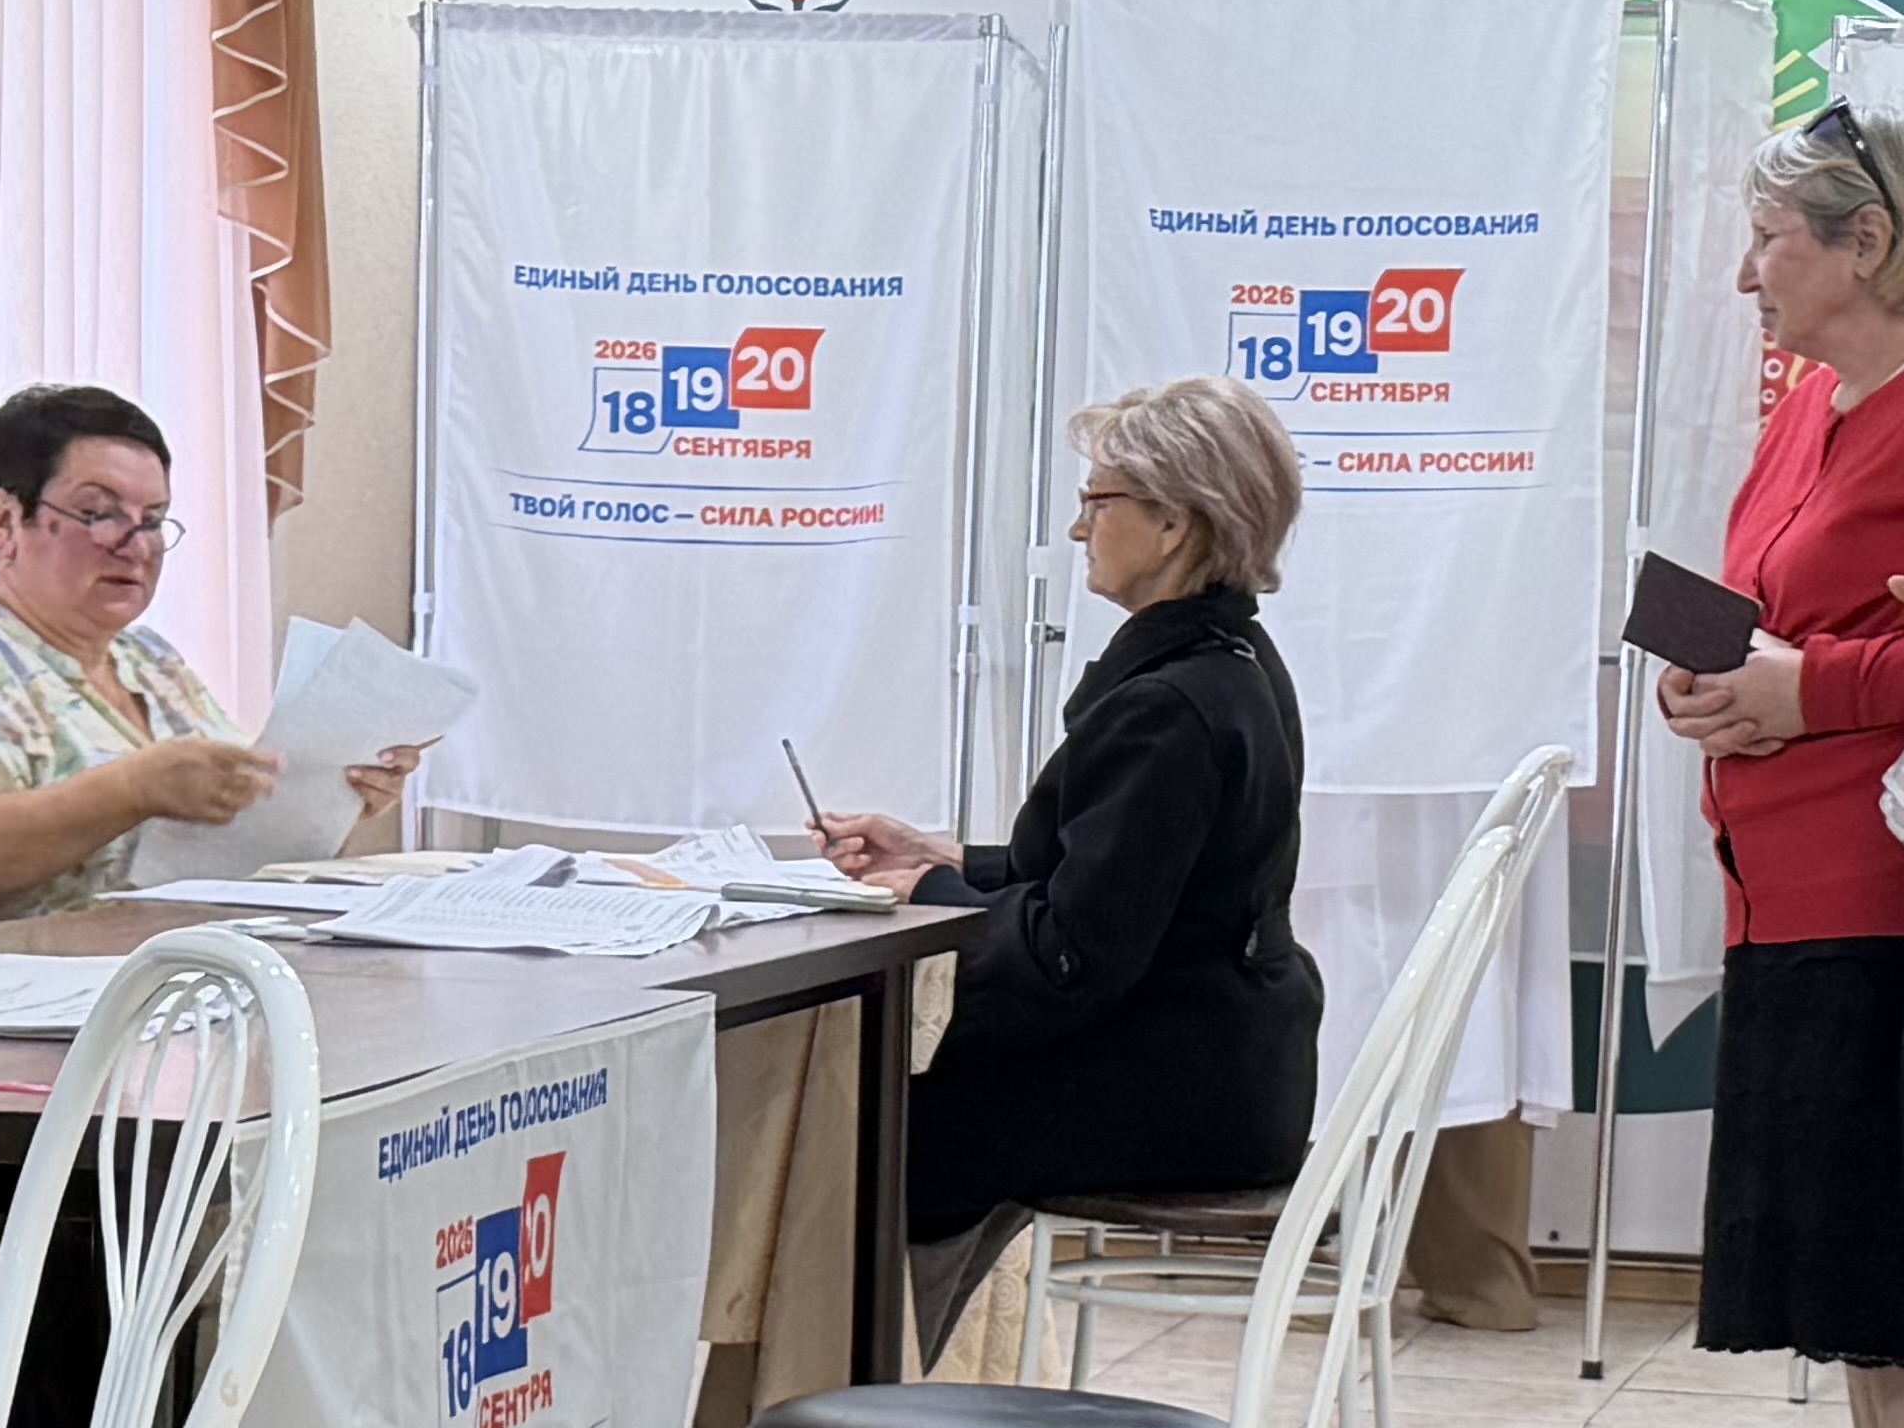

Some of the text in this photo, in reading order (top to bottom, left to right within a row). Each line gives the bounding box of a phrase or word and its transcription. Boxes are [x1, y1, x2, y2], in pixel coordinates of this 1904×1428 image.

[1149, 207, 1539, 239] ЕДИНЫЙ ДЕНЬ ГОЛОСОВАНИЯ
[514, 265, 904, 297] ЕДИНЫЙ ДЕНЬ ГОЛОСОВАНИЯ
[1231, 284, 1295, 305] 2026
[595, 339, 657, 360] 2026
[1238, 287, 1445, 381] 18 19 20
[602, 346, 805, 434] 18 19 20
[1310, 382, 1450, 402] СЕНТЯБРЯ
[673, 437, 811, 458] СЕНТЯБРЯ
[1338, 451, 1413, 472] СИЛА
[1420, 450, 1534, 472] РОССИИ!
[510, 492, 575, 519] ТВОЙ
[583, 500, 669, 524] ГОЛОС
[701, 504, 773, 527] СИЛА
[781, 502, 885, 528] РОССИИ!
[378, 1106, 450, 1183] ЕДИНЫЙ
[455, 1099, 496, 1159] ДЕНЬ
[436, 1215, 473, 1270] 2026
[443, 1193, 551, 1418] 18 19 0
